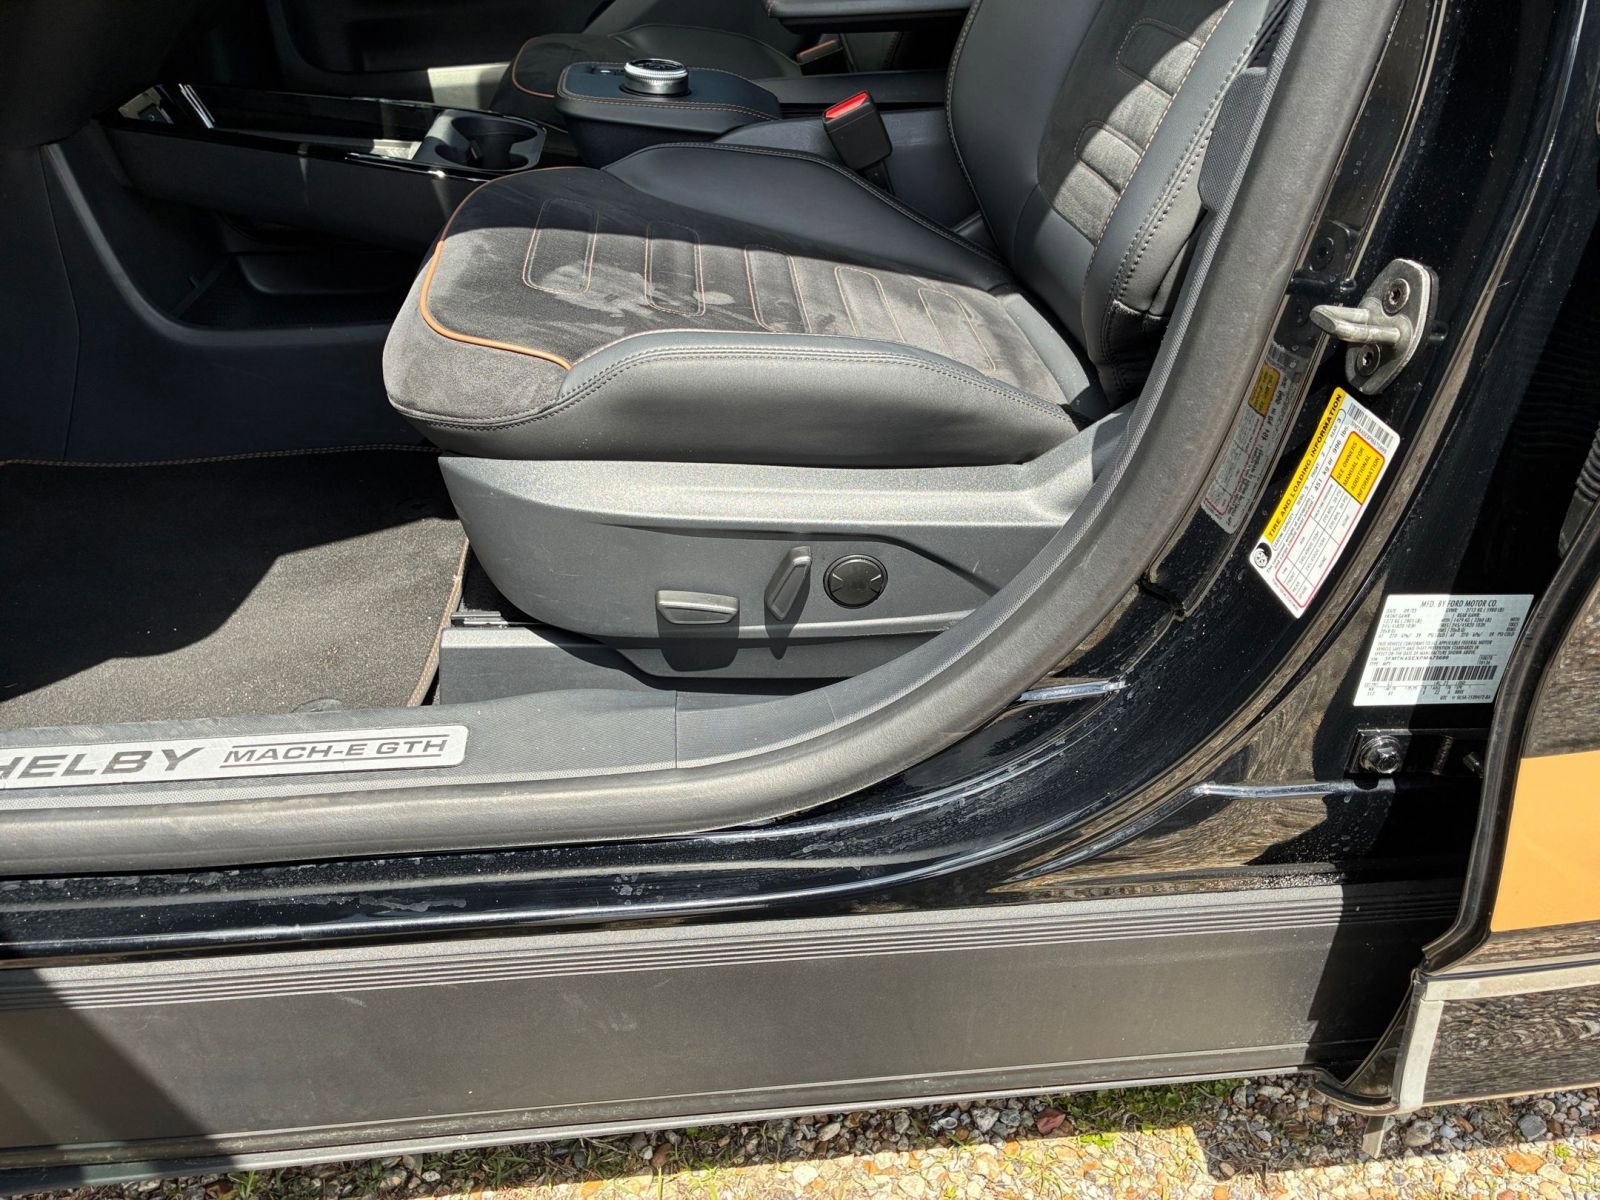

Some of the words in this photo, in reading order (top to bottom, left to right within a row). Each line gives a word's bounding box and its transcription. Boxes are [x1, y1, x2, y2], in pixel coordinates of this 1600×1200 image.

[1268, 515, 1281, 538] TIRE
[1279, 496, 1291, 517] AND
[1291, 458, 1312, 497] LOADING
[1310, 393, 1344, 457] INFORMATION
[1313, 477, 1323, 491] 451
[1321, 464, 1329, 476] kg
[1331, 439, 1342, 454] 996
[1335, 467, 1344, 480] SEE
[1341, 441, 1358, 468] OWNERS
[1341, 459, 1358, 486] MANUAL
[1355, 446, 1365, 460] FOR
[1349, 453, 1372, 491] ADDITIONAL
[1355, 456, 1381, 499] INFORMATION
[1446, 599, 1464, 607] FORD
[225, 743, 366, 764] MACH-E
[375, 738, 448, 757] GTH
